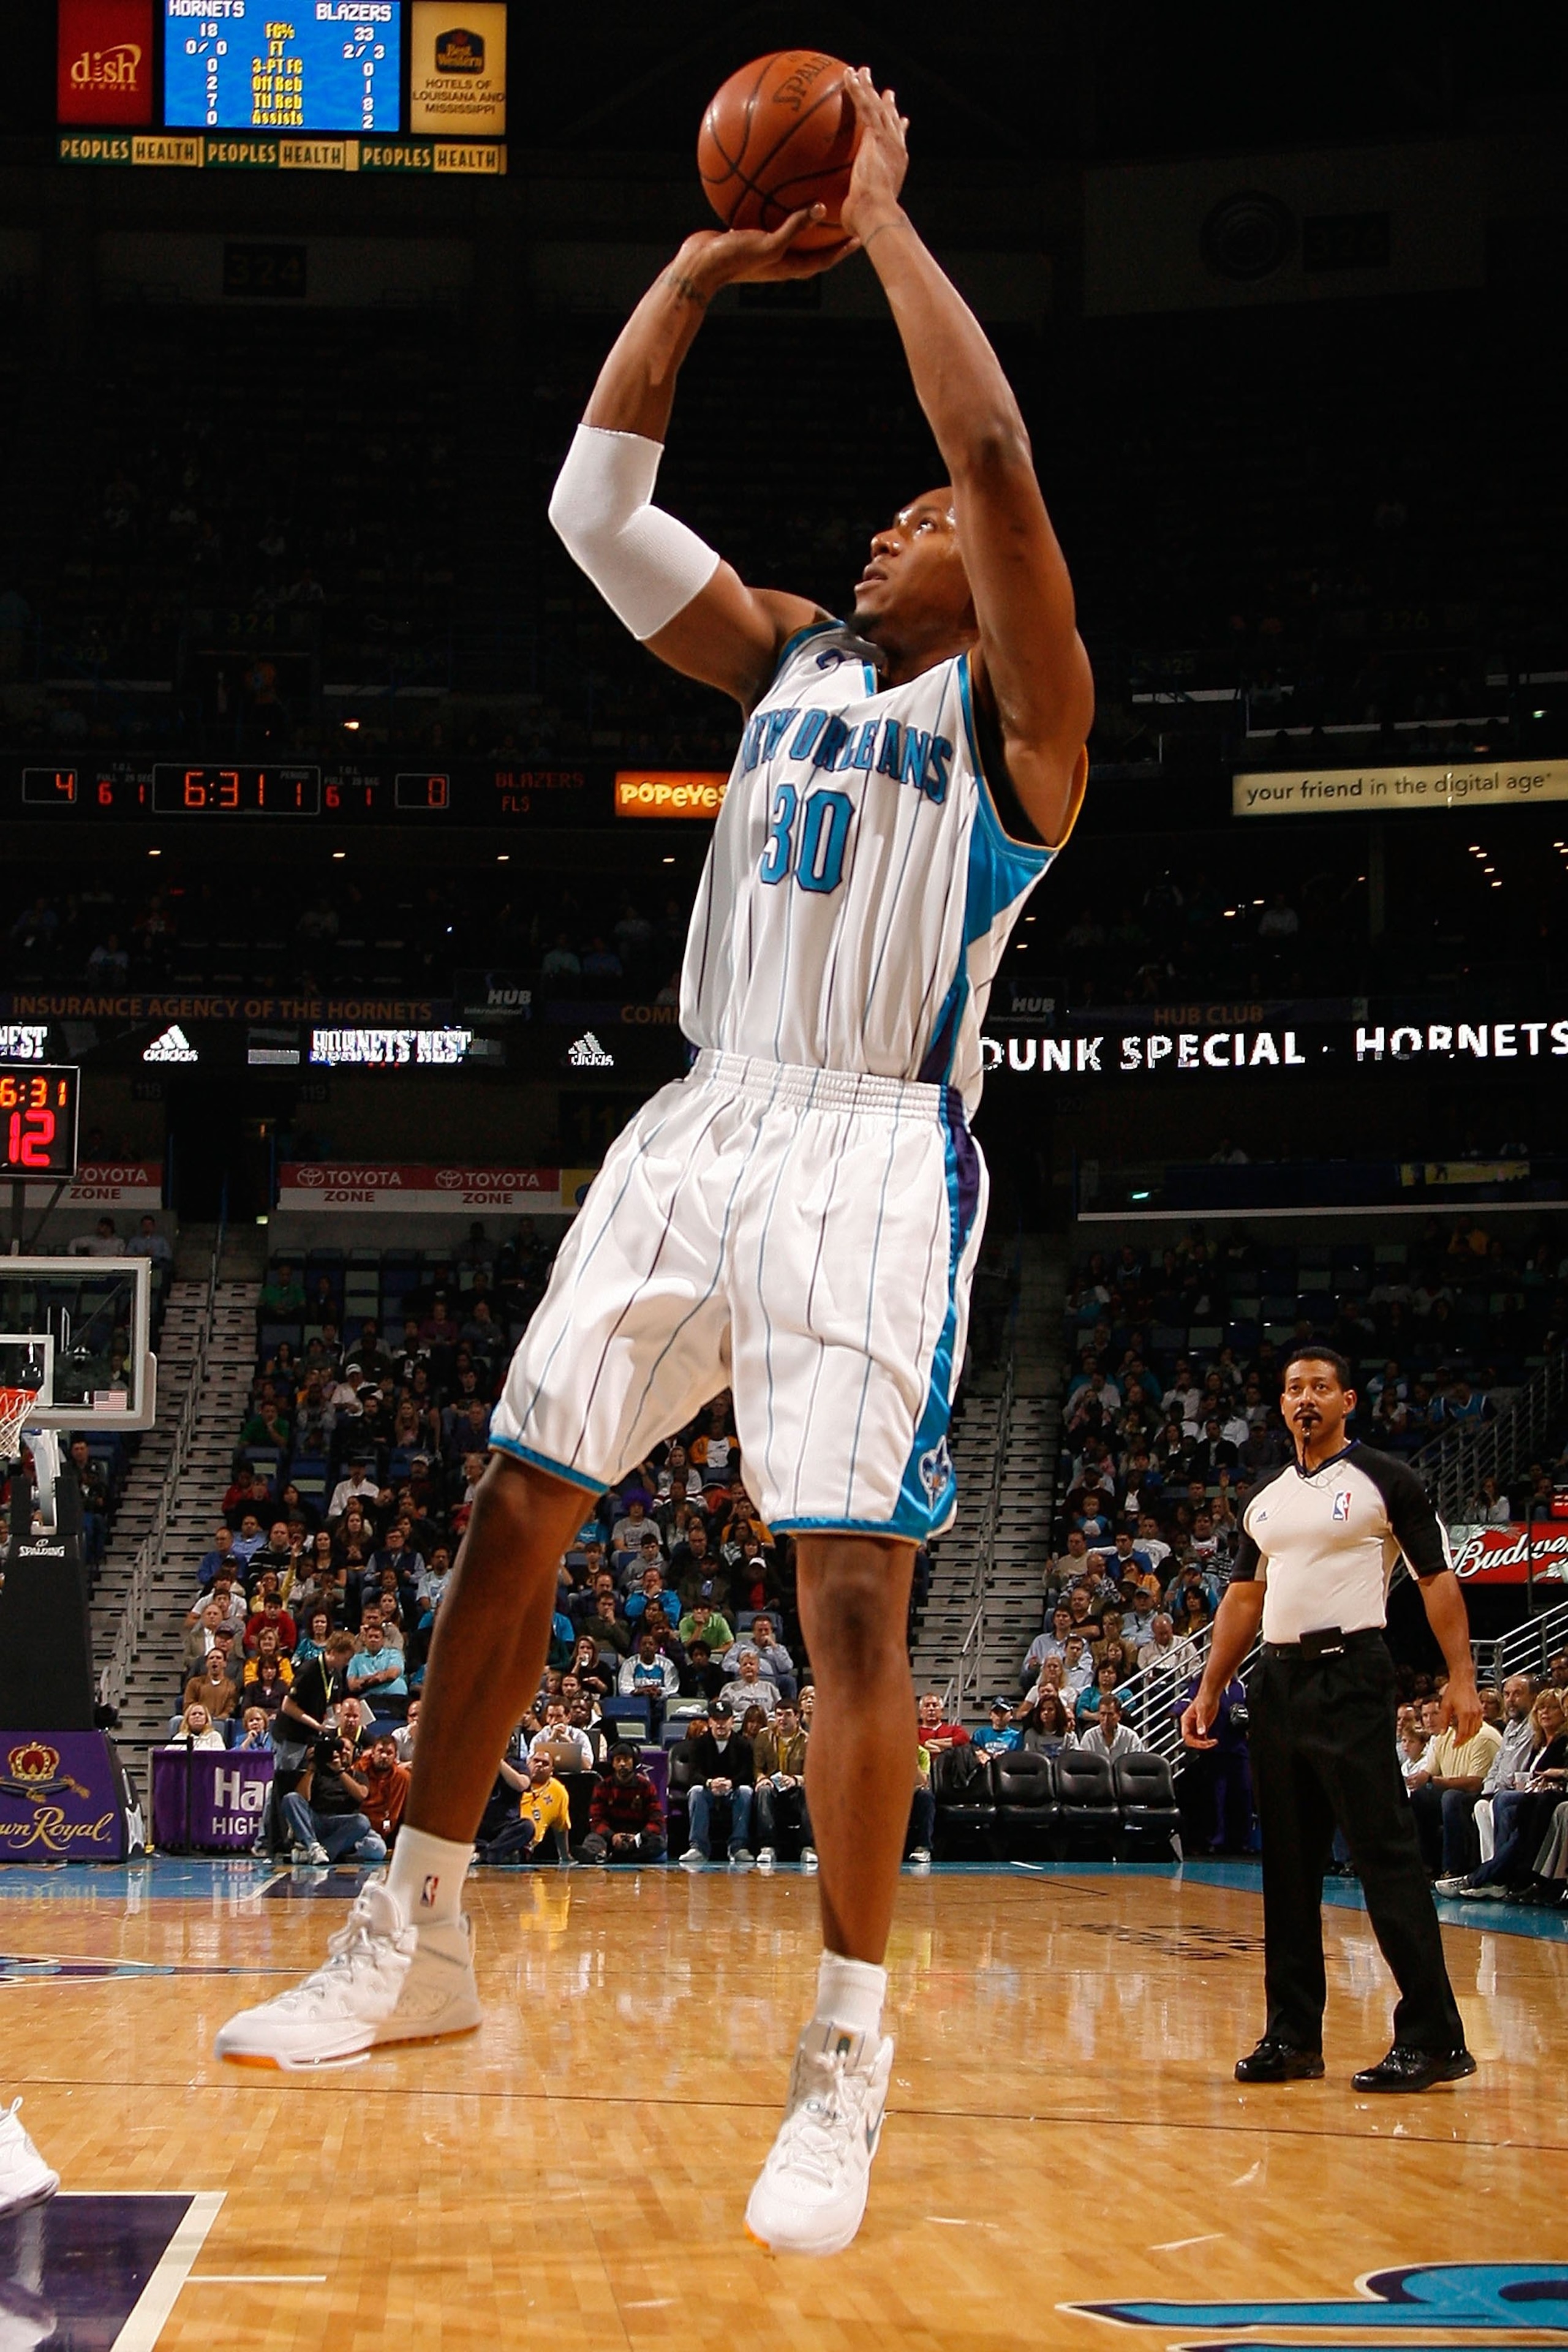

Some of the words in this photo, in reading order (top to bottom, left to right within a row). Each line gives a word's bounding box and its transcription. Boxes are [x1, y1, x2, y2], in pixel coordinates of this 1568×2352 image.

[168, 0, 245, 17] HORNETS
[316, 2, 392, 21] BLAZERS
[200, 22, 218, 37] 18
[270, 40, 285, 56] FT
[70, 47, 139, 83] dish
[206, 58, 218, 72] 0
[252, 58, 284, 74] 3-PT
[363, 61, 374, 76] 0
[206, 75, 218, 90] 2
[275, 76, 303, 92] Reb
[365, 79, 372, 94] 1
[426, 79, 472, 89] HOTELS
[477, 80, 492, 89] OF
[206, 92, 218, 107] 7
[275, 93, 303, 110] Reb
[412, 91, 475, 101] LOUISIANA
[479, 92, 505, 102] AND
[206, 110, 218, 125] 0
[252, 108, 303, 126] Assists
[425, 104, 496, 115] MISSISSIPPI
[363, 115, 374, 129] 2
[61, 140, 129, 159] PEOPLES
[136, 142, 195, 160] HEALTH
[208, 143, 276, 163] PEOPLES
[284, 145, 341, 164] HEALTH
[363, 147, 431, 167] PEOPLES
[438, 149, 496, 168] HEALTH
[789, 707, 952, 805] ORLEANS
[55, 772, 74, 801] 4
[494, 771, 584, 789] BLAZERS
[1247, 786, 1293, 806] your
[1300, 778, 1362, 799] friend
[1370, 778, 1387, 795] in
[1395, 775, 1427, 794] the
[1434, 771, 1499, 798] digital
[97, 781, 114, 807] 6
[138, 783, 146, 806] 1
[184, 771, 267, 807] 6:31
[295, 780, 304, 808] 1
[324, 784, 341, 809] 6
[365, 785, 374, 808] 1
[427, 776, 447, 807] 0
[760, 783, 856, 895] 30
[487, 989, 533, 1005] HUB
[1011, 998, 1055, 1012] HUB
[12, 995, 142, 1017] INSURANCE
[148, 997, 239, 1018] AGENCY
[244, 1000, 274, 1019] OF
[279, 1000, 322, 1020] THE
[328, 1001, 432, 1020] HORNETS
[1153, 1006, 1201, 1026] HUB
[1207, 1005, 1264, 1024] CLUB
[982, 1037, 1104, 1072] DUNK
[1120, 1031, 1306, 1070] SPECIAL
[1355, 1020, 1568, 1061] HORNETS
[0, 1076, 68, 1109] 6:31
[8, 1109, 56, 1168] 12
[328, 1170, 402, 1185] TOYOTA
[465, 1172, 540, 1188] TOYOTA
[70, 1187, 121, 1200] ZONE
[324, 1191, 375, 1202] ZONE
[462, 1193, 513, 1204] ZONE
[18, 1545, 65, 1558] SPALDING
[7, 1806, 115, 1851] Royal
